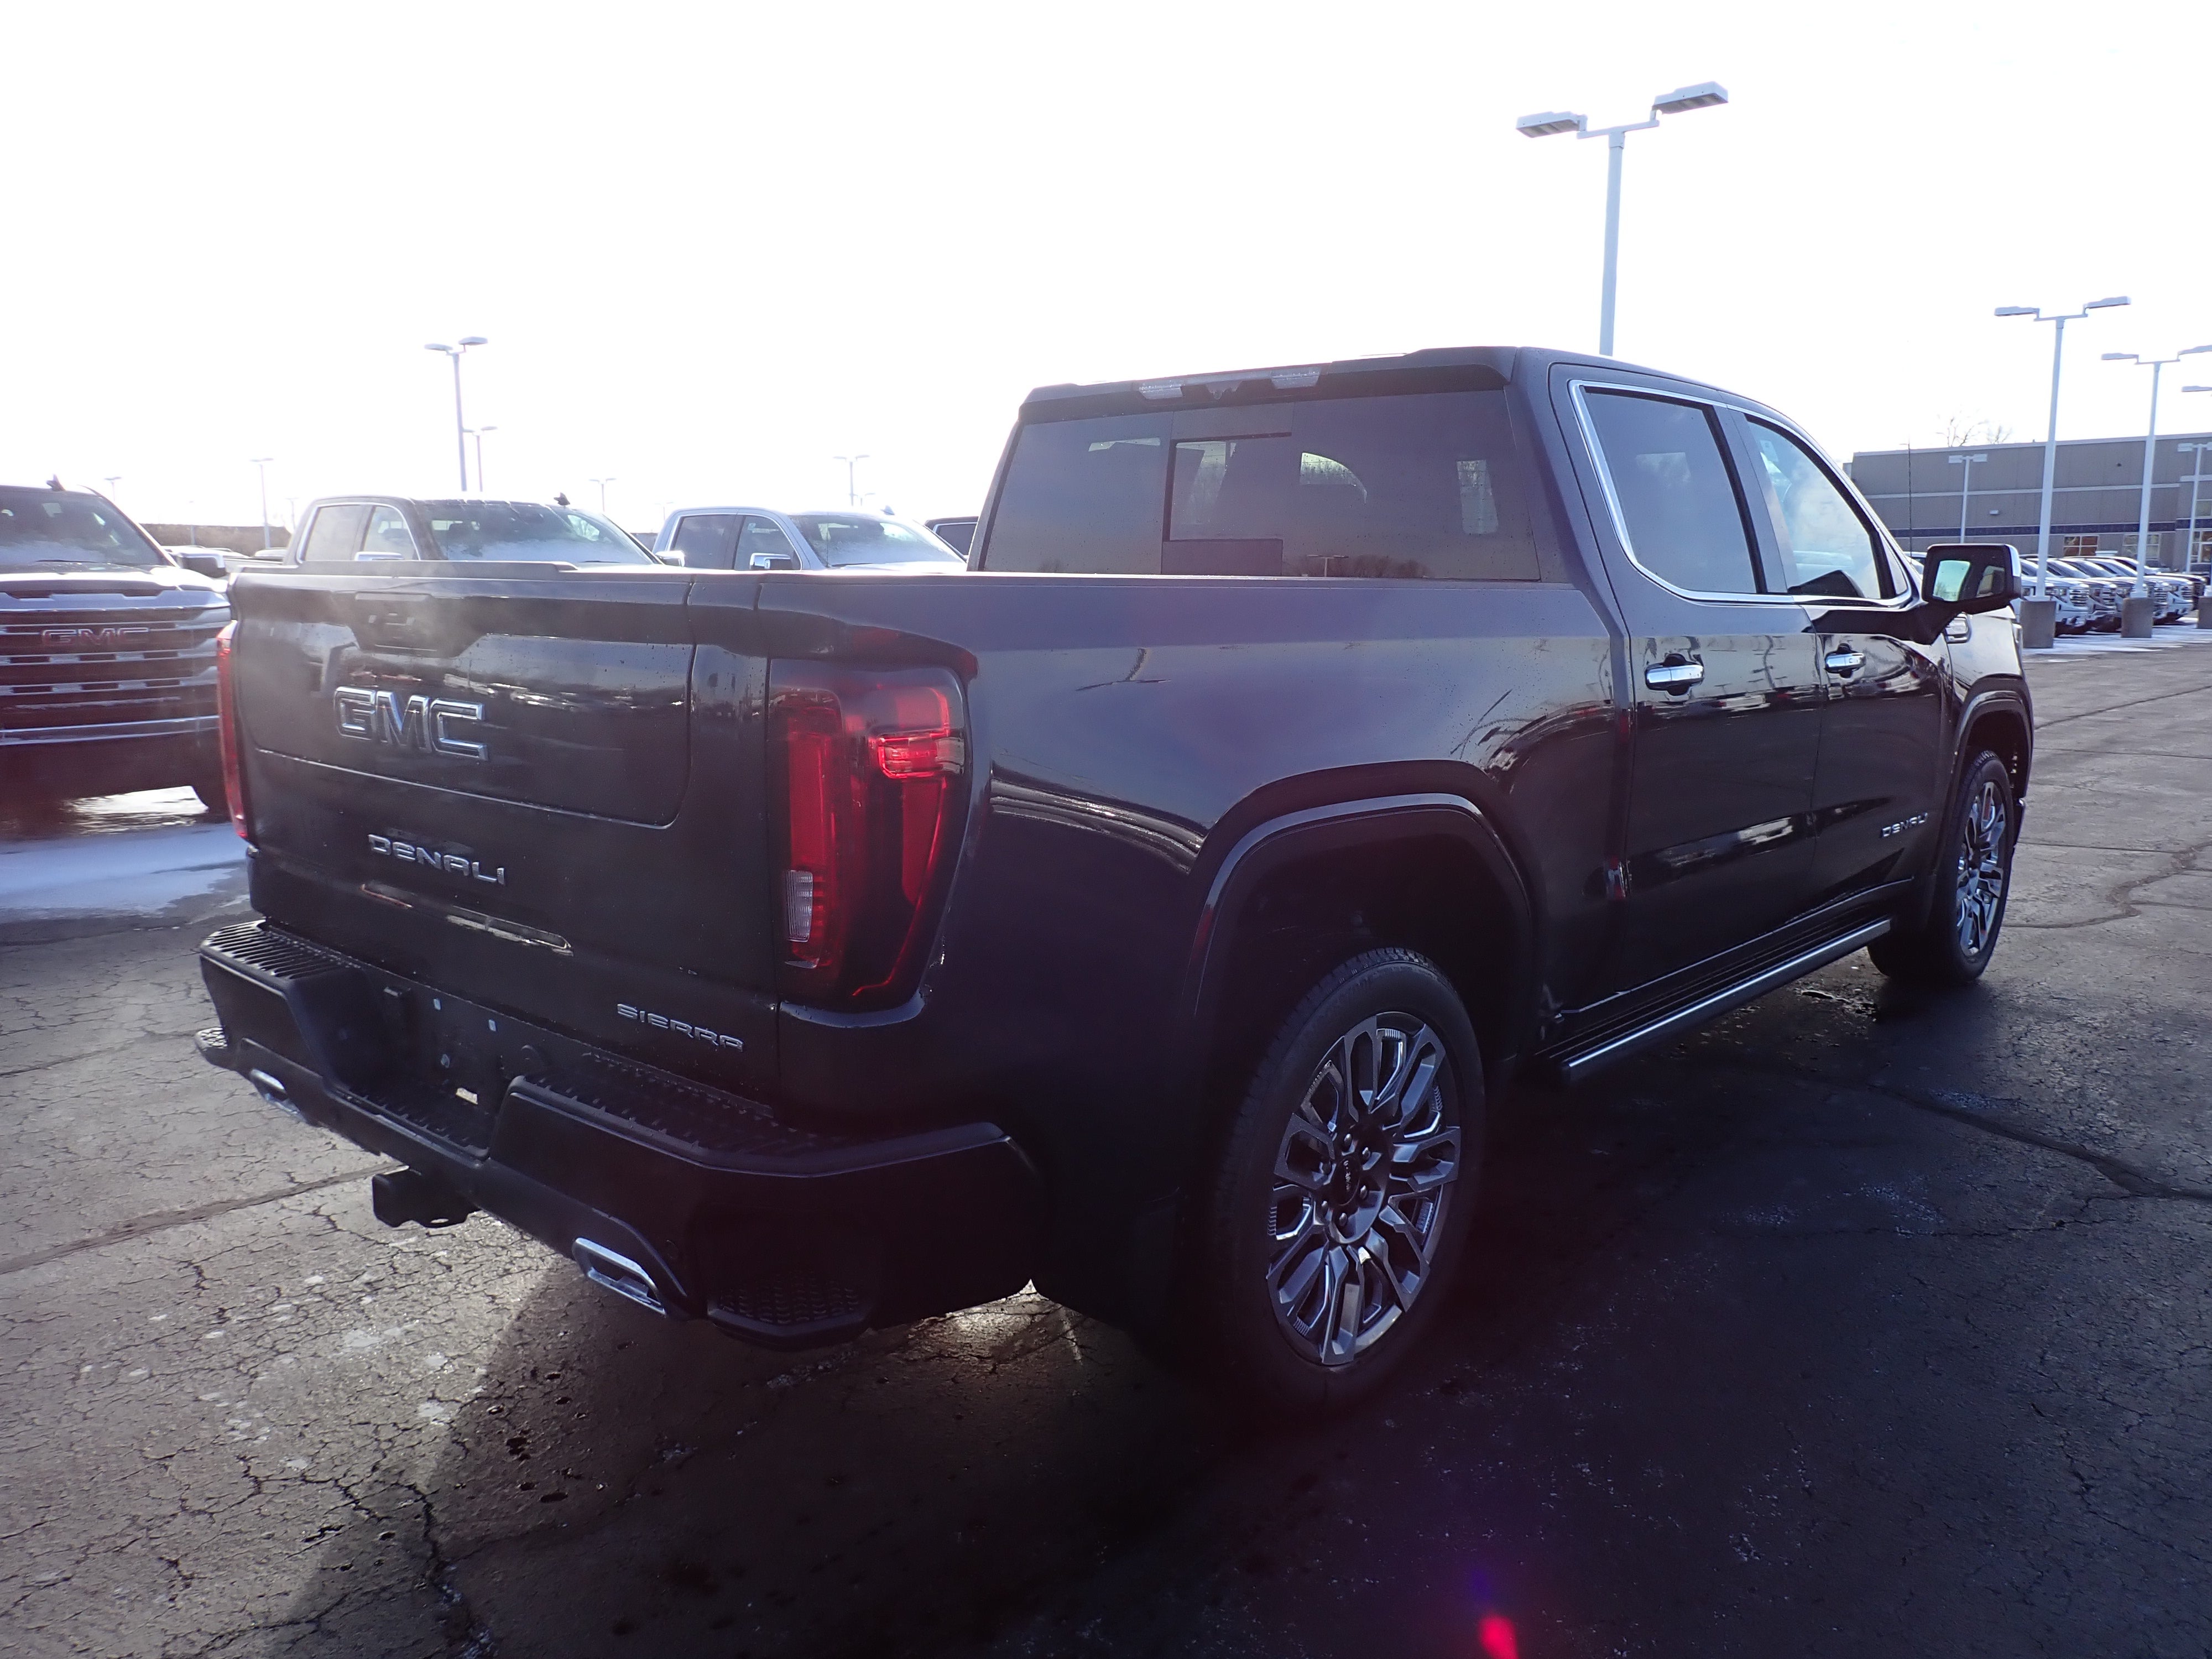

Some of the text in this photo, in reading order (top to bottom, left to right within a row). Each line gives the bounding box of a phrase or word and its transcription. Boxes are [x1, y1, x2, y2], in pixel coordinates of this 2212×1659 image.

[42, 627, 150, 646] GMC
[334, 686, 488, 760] GMC
[368, 834, 505, 885] DENALI
[617, 1003, 744, 1052] SIERRA
